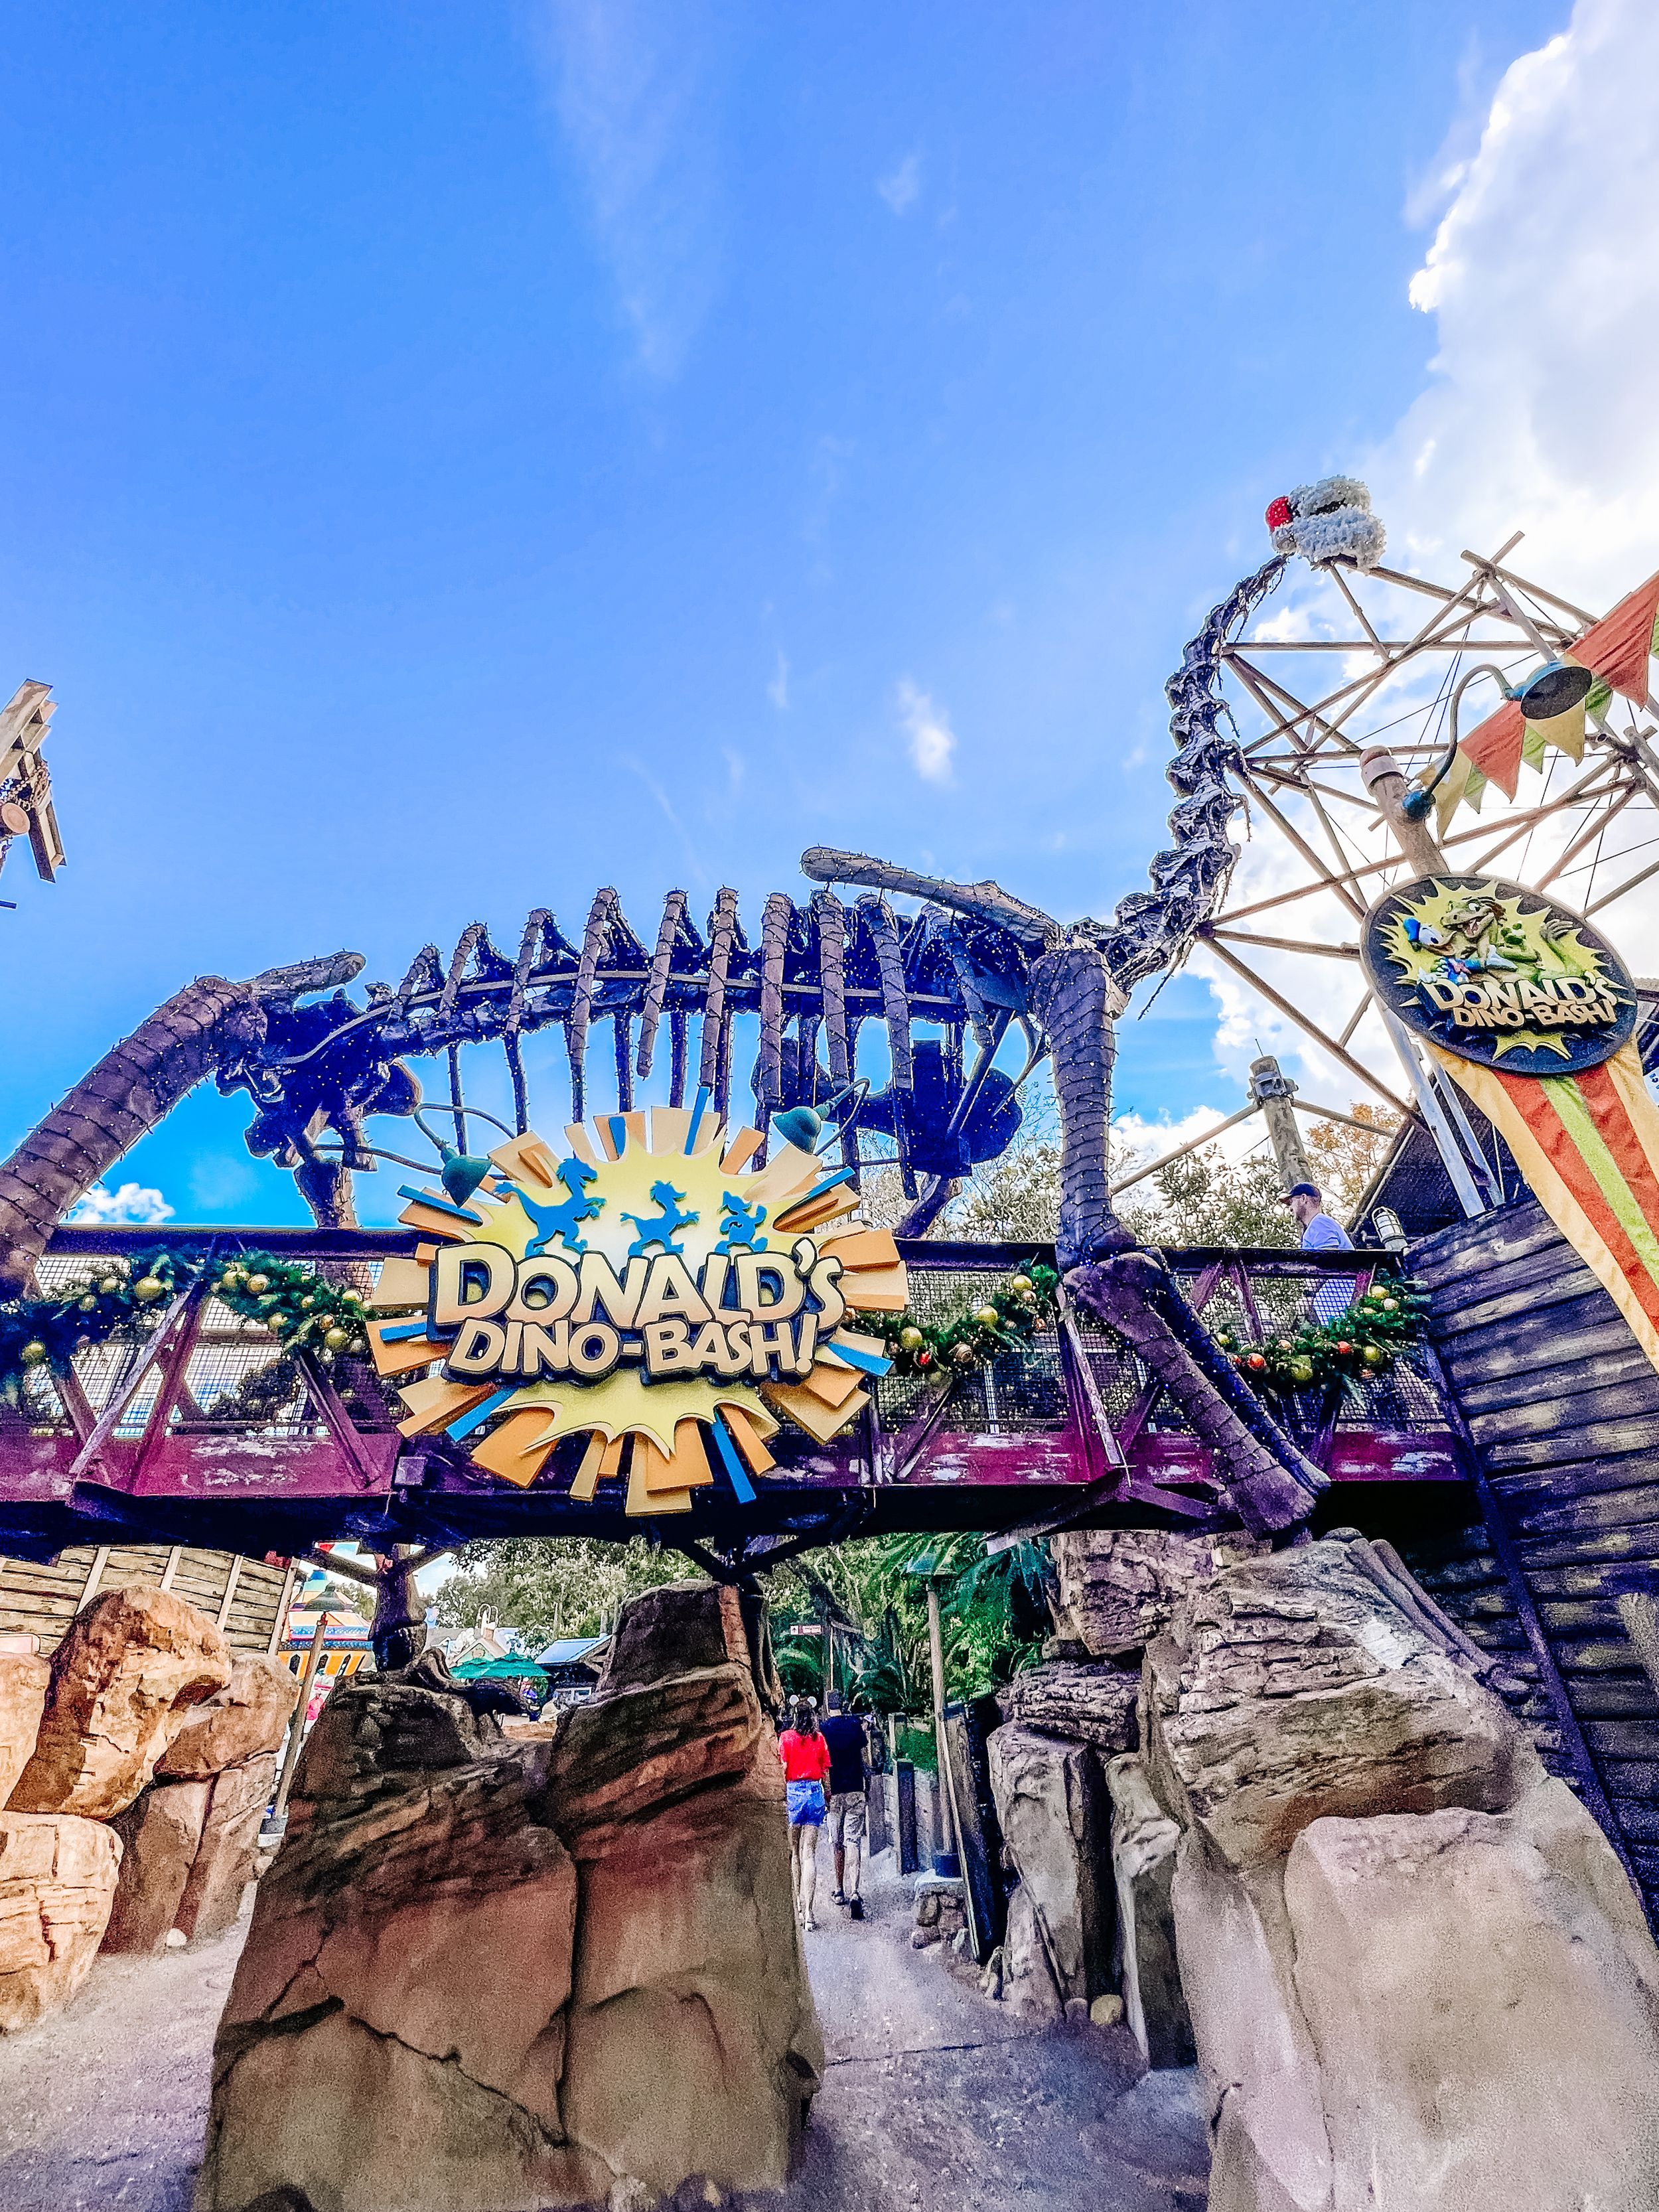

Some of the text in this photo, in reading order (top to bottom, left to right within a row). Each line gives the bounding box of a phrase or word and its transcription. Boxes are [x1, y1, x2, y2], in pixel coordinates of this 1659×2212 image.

[1422, 970, 1618, 1010] DONALD'S
[435, 1238, 844, 1327] DONALD'S
[449, 1313, 818, 1374] DINO-BASH!
